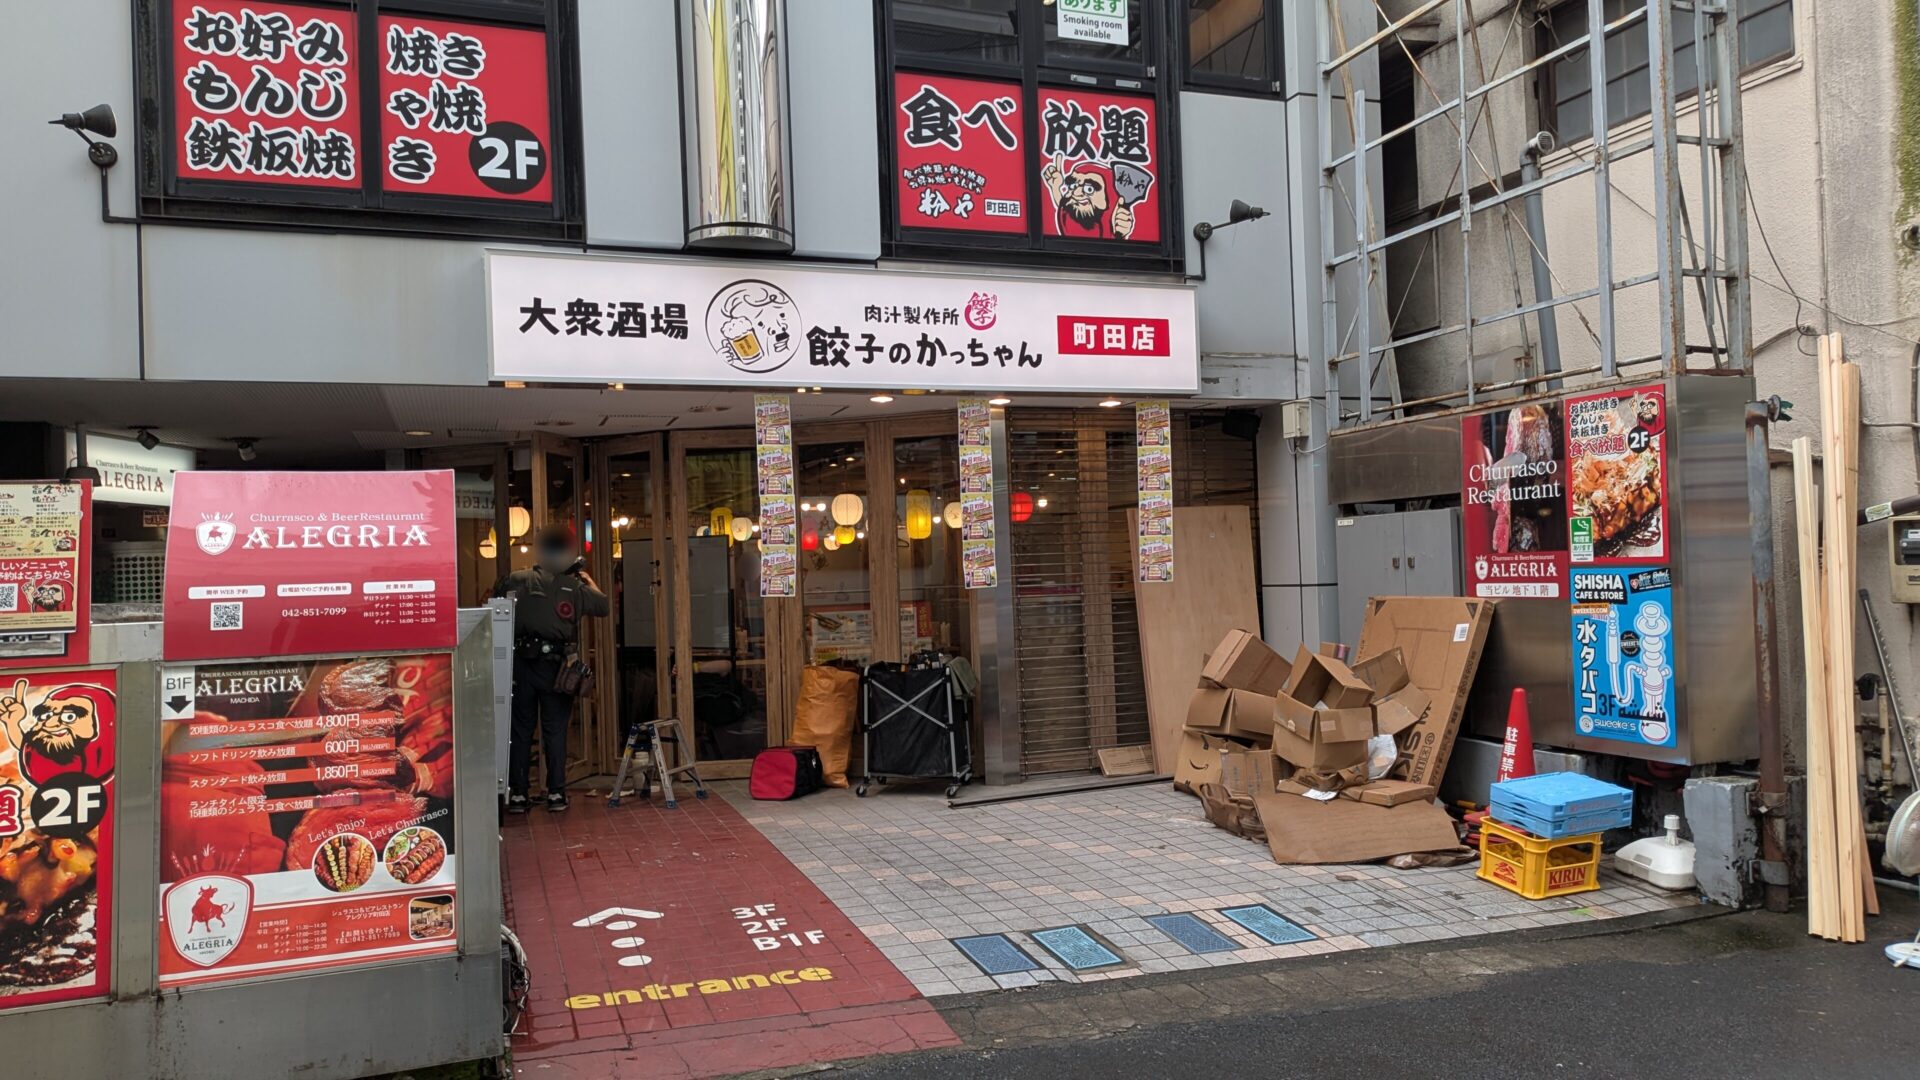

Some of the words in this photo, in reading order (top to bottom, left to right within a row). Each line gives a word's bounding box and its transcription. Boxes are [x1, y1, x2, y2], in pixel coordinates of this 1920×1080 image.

[1063, 14, 1100, 28] Smoking
[1101, 21, 1123, 30] room
[185, 7, 348, 65] お好み
[388, 25, 485, 78] 焼き
[1074, 28, 1111, 39] available
[185, 61, 347, 121] もんじ
[902, 85, 1018, 150] 食べ
[1042, 99, 1151, 164] 放題
[185, 118, 355, 180] 鉄板焼
[389, 137, 435, 183] き
[478, 138, 539, 179] 2F
[918, 187, 974, 218] 粉や
[986, 201, 1019, 214] 町田店
[519, 297, 688, 340] 大衆酒場
[864, 304, 960, 326] 肉汁製作所
[806, 325, 1043, 369] 餃子のかっちゃん
[1073, 322, 1155, 351] 町田店
[1571, 398, 1618, 415] お好み焼き
[1571, 414, 1605, 426] もんじゃ
[1571, 424, 1609, 438] 鉄板焼き
[1570, 435, 1626, 458] 食べ放題
[1630, 431, 1649, 449] 2F
[99, 471, 164, 492] LEGRIA
[1469, 460, 1557, 483] Churrasco
[1467, 479, 1561, 505] Restaurant
[250, 513, 314, 522] Churrasco
[317, 513, 327, 522] &
[242, 524, 432, 549] ALEGRIA
[1490, 562, 1558, 577] ALEGRIA
[1486, 586, 1510, 596] 当ビル
[1574, 574, 1623, 590] SHISHA
[1574, 591, 1593, 600] CAFE
[1594, 591, 1599, 600] &
[1600, 591, 1624, 600] STORE
[282, 607, 347, 618] 042-851-7099
[1577, 619, 1598, 714] 水タバコ
[166, 677, 192, 690] B1F
[195, 675, 306, 697] ALEGRIA
[1599, 693, 1616, 717] 3F
[190, 721, 314, 736] 20種類のシュラスコ食べ放題
[316, 714, 360, 728] 4,800円
[190, 747, 296, 762] ソフトドリンク飲み放題
[325, 740, 359, 753] 600円
[190, 772, 287, 788] スタンダード飲み放題
[315, 764, 359, 780] 1,850円
[39, 785, 101, 826] 2F
[190, 795, 267, 809] ランチタイム限定
[190, 800, 314, 818] 15種類のシュラスコ食べ放題
[308, 827, 334, 843] Let's
[335, 817, 367, 832] Enjoy
[368, 825, 394, 840] Let's
[395, 807, 449, 830] Churrasco
[1549, 867, 1586, 884] KIRIN
[731, 903, 777, 920] 3F
[742, 917, 788, 935] 2F
[183, 938, 233, 951] ALEGRIA
[751, 929, 826, 952] B1F
[564, 966, 833, 1010] entrance
